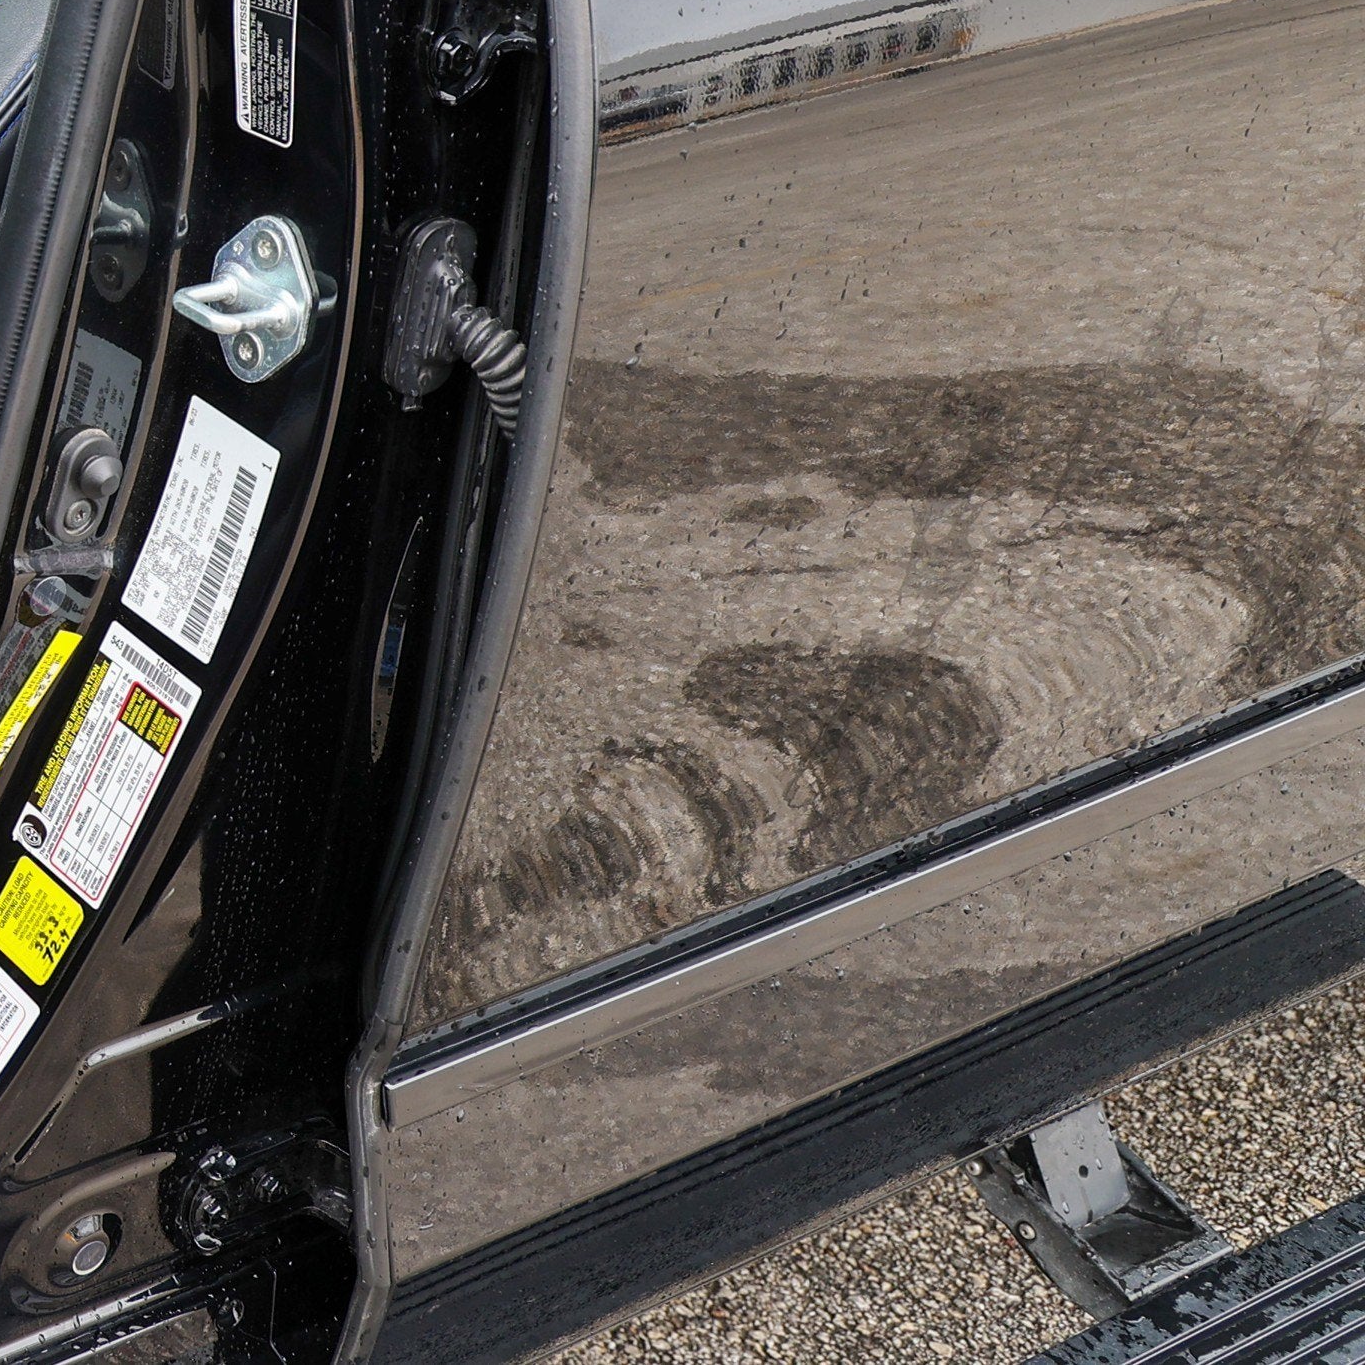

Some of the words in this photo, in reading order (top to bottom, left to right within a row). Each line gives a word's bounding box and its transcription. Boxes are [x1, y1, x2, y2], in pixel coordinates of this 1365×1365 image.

[270, 54, 275, 64] TO
[258, 85, 262, 97] OR
[262, 463, 272, 471] 1
[111, 635, 125, 651] 543
[35, 775, 47, 793] TIRE
[44, 757, 56, 776] AND
[52, 721, 73, 758] LOADING
[70, 664, 100, 721] INFORMATION
[37, 758, 63, 807] RENSEIGNEMENTS
[60, 745, 69, 759] SUR
[66, 734, 74, 746] LES
[80, 707, 87, 716] ET
[84, 699, 91, 708] LE
[88, 660, 109, 700] CHARGEMENT
[12, 873, 24, 889] LOAD
[0, 899, 18, 928] CARRYING
[15, 871, 33, 900] CAPACITY
[13, 892, 31, 919] REDUCED
